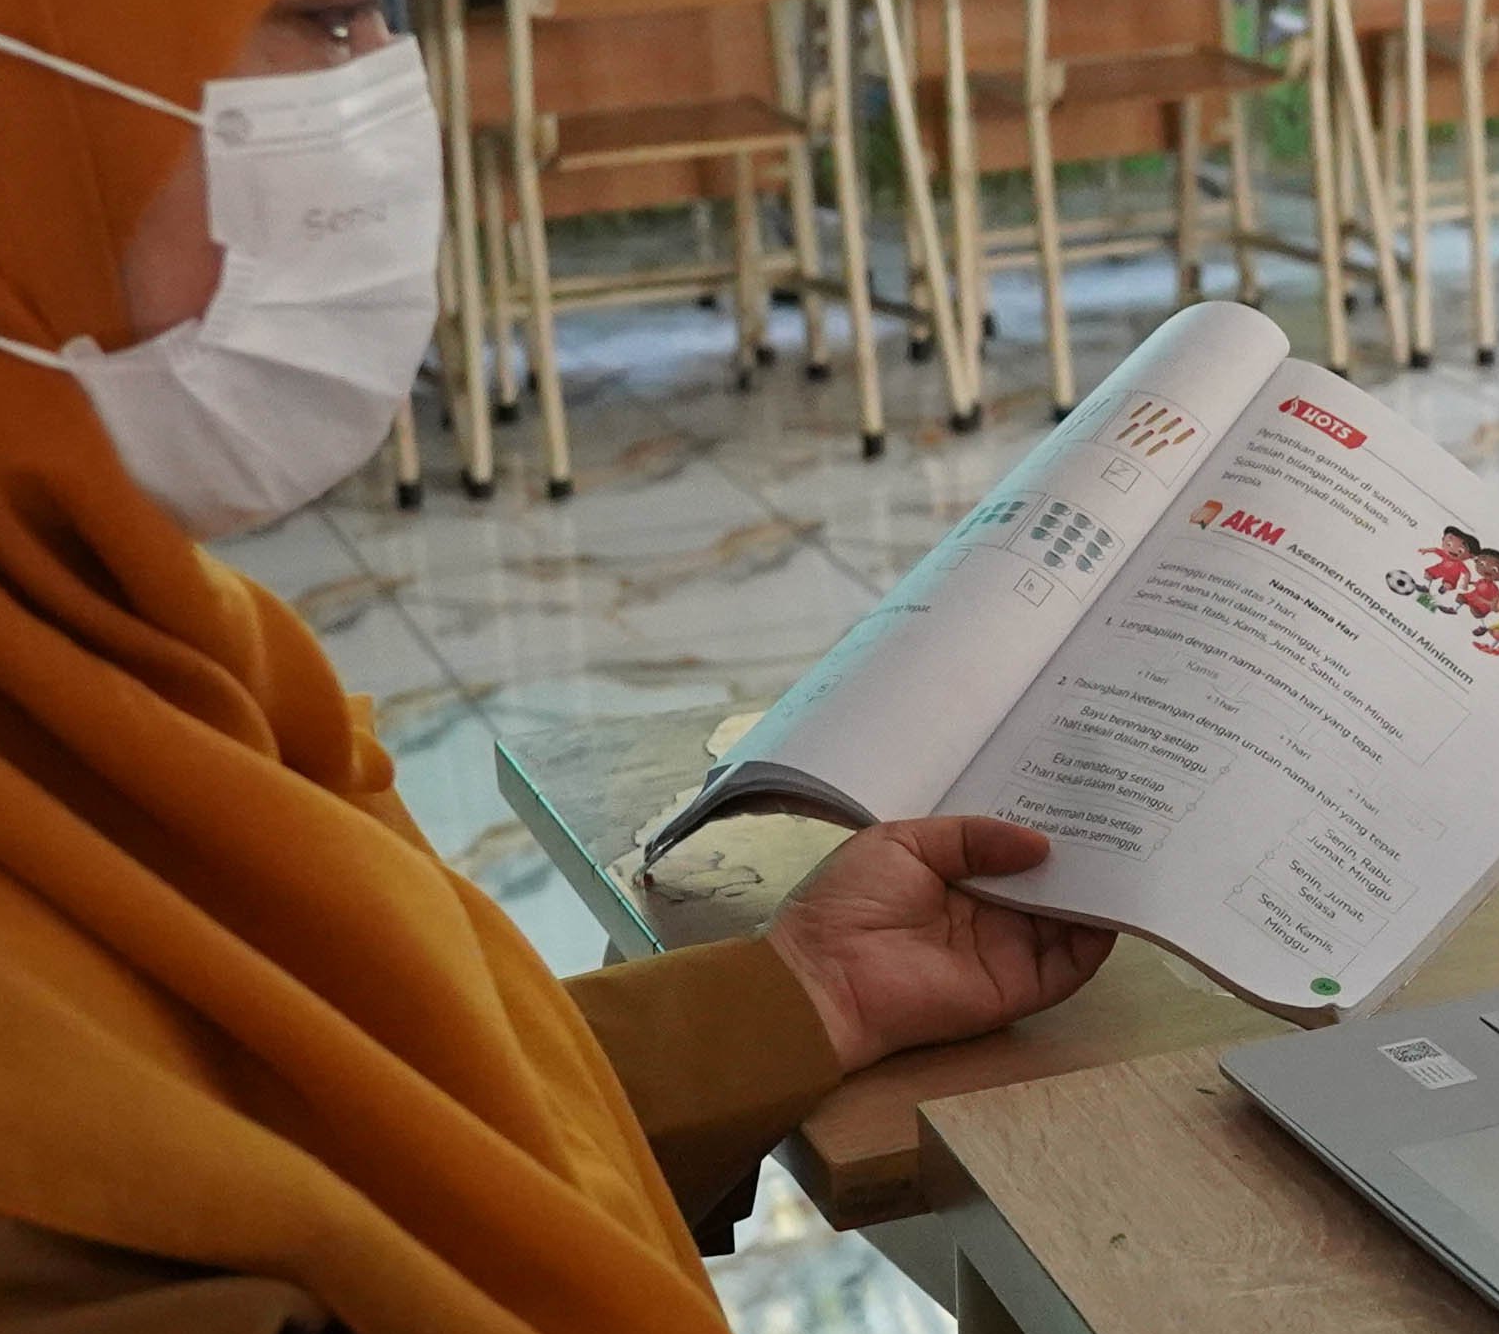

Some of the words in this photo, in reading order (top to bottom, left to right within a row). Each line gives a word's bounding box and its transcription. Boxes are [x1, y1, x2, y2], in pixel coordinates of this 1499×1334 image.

[1301, 406, 1353, 440] HOTS
[1257, 427, 1315, 457] Perhatikan
[1316, 454, 1360, 484] gambar
[1360, 479, 1372, 492] di
[1372, 490, 1419, 530] samping.
[1286, 455, 1334, 486] bilangan
[1333, 481, 1363, 505] pada
[1363, 498, 1390, 525] kaos.
[1284, 473, 1329, 503] menjadi
[1329, 497, 1377, 535] bilangan
[1207, 573, 1241, 593] terdiri
[1240, 585, 1265, 603] atas
[1266, 597, 1275, 607] 7
[1221, 510, 1286, 546] AKM
[1287, 543, 1343, 582] Asesmen
[1344, 577, 1419, 640] Kompetensi
[1416, 636, 1475, 686] Minimum
[1268, 578, 1335, 624] Nama-Nama
[1334, 620, 1360, 642] Hari
[1181, 581, 1211, 599] nama
[1211, 589, 1232, 606] hari
[1232, 599, 1268, 623] dalam
[1322, 652, 1351, 678] yaitu
[1185, 661, 1220, 681] Kamis
[1201, 605, 1231, 627] Rabu,
[1342, 688, 1365, 707] dan
[1118, 618, 1185, 643] Lengkapilah
[1185, 636, 1228, 661] dengan
[1229, 654, 1304, 699] nama-nama
[1300, 692, 1324, 715] hari
[1322, 712, 1351, 738] yang
[1351, 734, 1384, 765] tepat.
[1059, 717, 1082, 731] hari
[1081, 722, 1114, 739] sekali
[1113, 731, 1150, 751] dalam
[1080, 705, 1108, 721] Bayu
[1108, 712, 1161, 741] berenang
[1163, 732, 1199, 754] setiap
[1292, 742, 1312, 761] hari
[1021, 759, 1032, 772] 2
[1032, 763, 1055, 779] hari
[1052, 752, 1074, 767] Eka
[1074, 758, 1129, 782] menabung
[1129, 771, 1165, 793] setiap
[1073, 677, 1130, 700] Pasangkan
[1129, 691, 1195, 722] keterangan
[1194, 717, 1241, 743] dengan
[1241, 739, 1282, 768] urutan
[1282, 765, 1315, 793] nama
[1316, 789, 1340, 813] hari
[1339, 809, 1368, 837] yang
[1004, 809, 1030, 826] hari
[1059, 824, 1090, 840] dalam
[1015, 794, 1046, 812] Farel
[1107, 816, 1144, 836] setiap
[1360, 795, 1380, 816] hari
[1324, 828, 1357, 861] Senin,
[1359, 857, 1393, 887] Rabu,
[1288, 859, 1322, 892] Senin,
[1324, 891, 1365, 922] Jumat,
[1297, 886, 1337, 919] Selasa
[1348, 866, 1392, 902] Minggu
[1258, 892, 1292, 927] Senin,
[1295, 922, 1334, 954] Kamis,
[1264, 917, 1310, 954] Minggu
